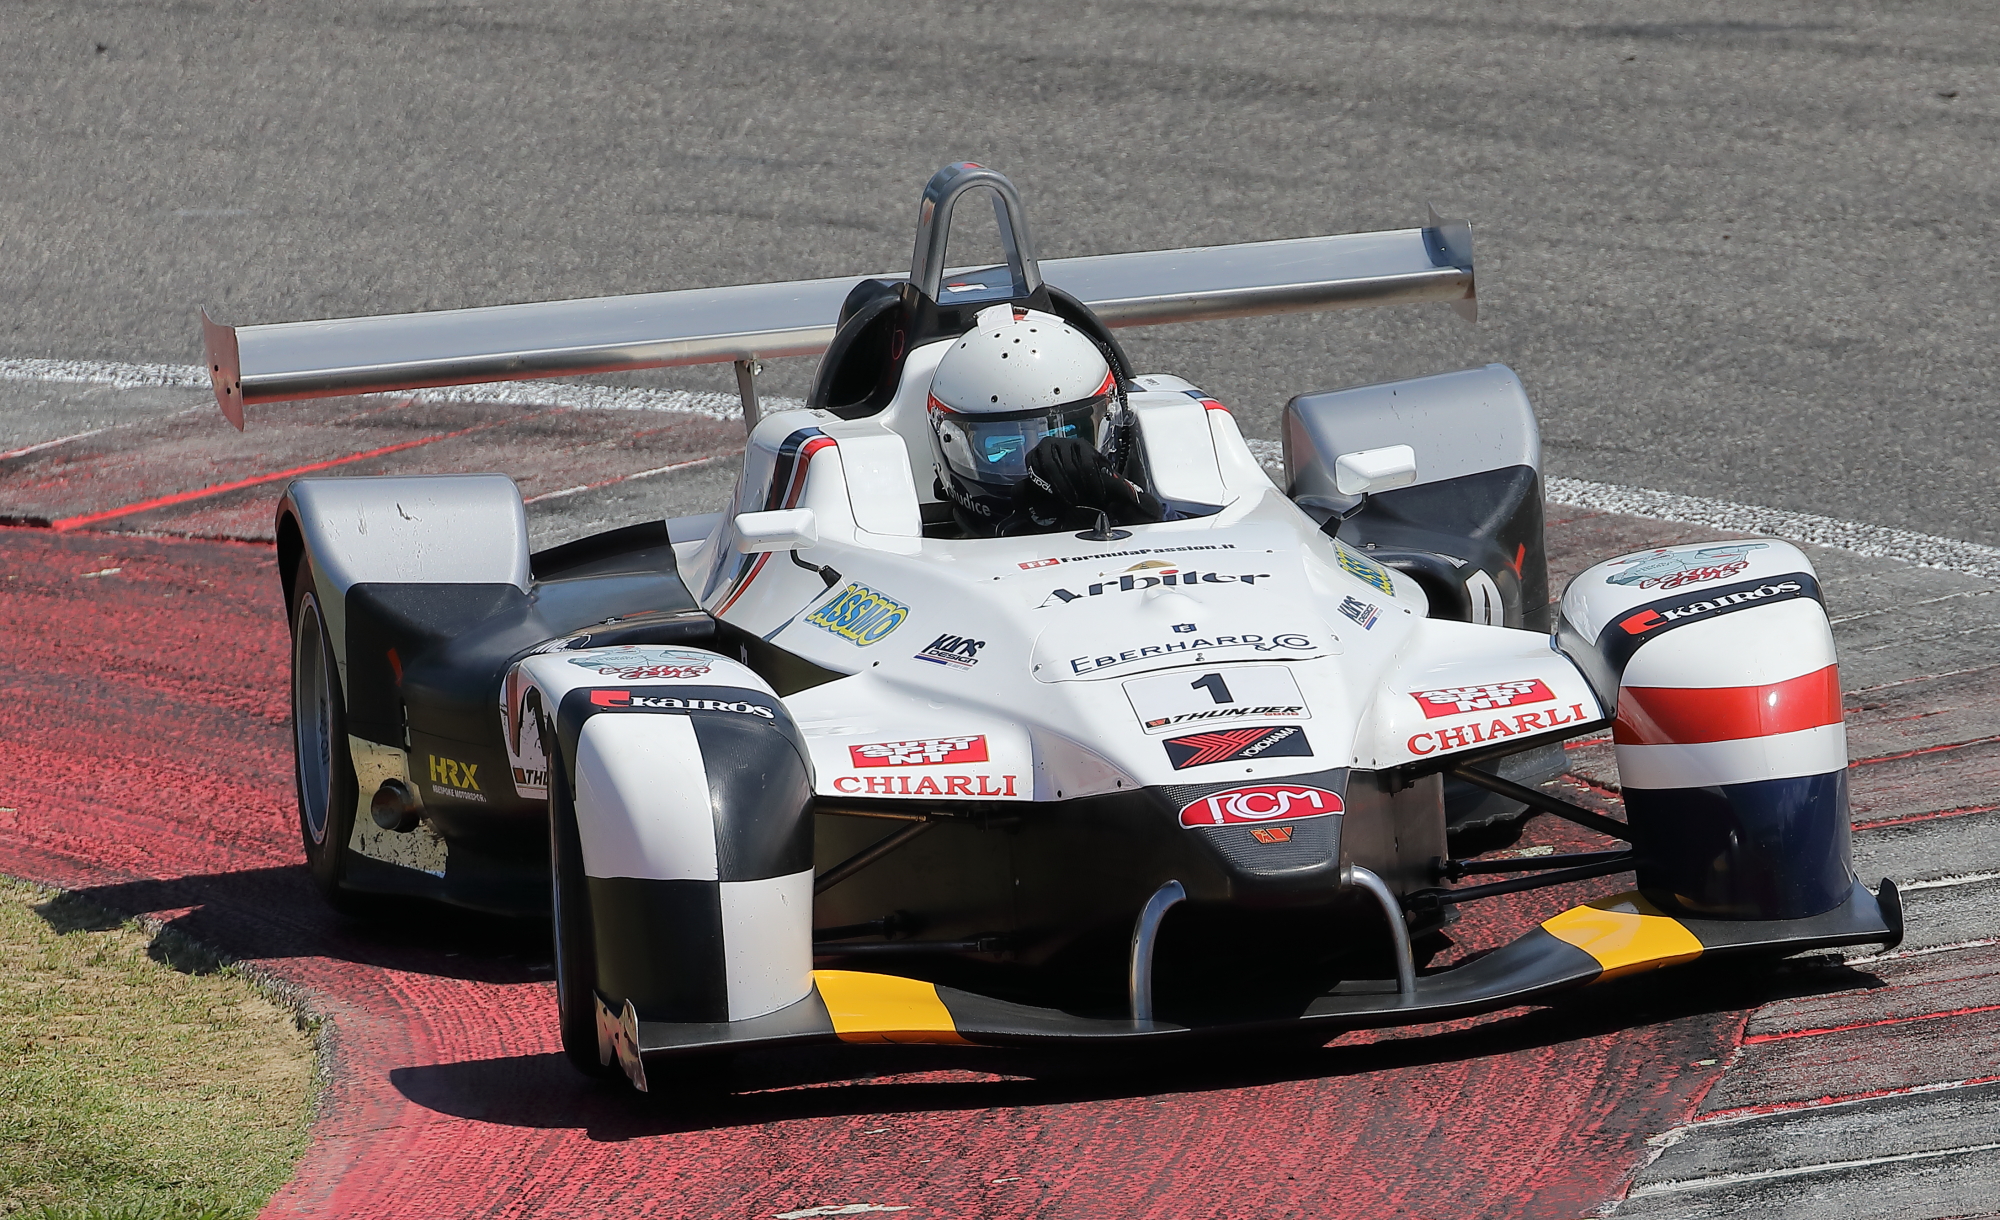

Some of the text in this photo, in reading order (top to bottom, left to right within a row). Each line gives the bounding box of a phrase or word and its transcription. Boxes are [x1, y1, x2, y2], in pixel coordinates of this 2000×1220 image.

[1061, 544, 1238, 563] FormulaPassion.it
[1032, 570, 1271, 610] Arbiter
[1070, 634, 1264, 674] EBERHARD
[1190, 672, 1234, 705] 1
[1419, 681, 1538, 698] AUTO
[1172, 706, 1303, 723] THUNDER
[1406, 703, 1587, 756] CHIARLI
[855, 736, 979, 753] AUTO
[1237, 727, 1299, 758] YOKOHAMA
[429, 754, 480, 791] HRX
[833, 775, 1018, 797] CHIARLI
